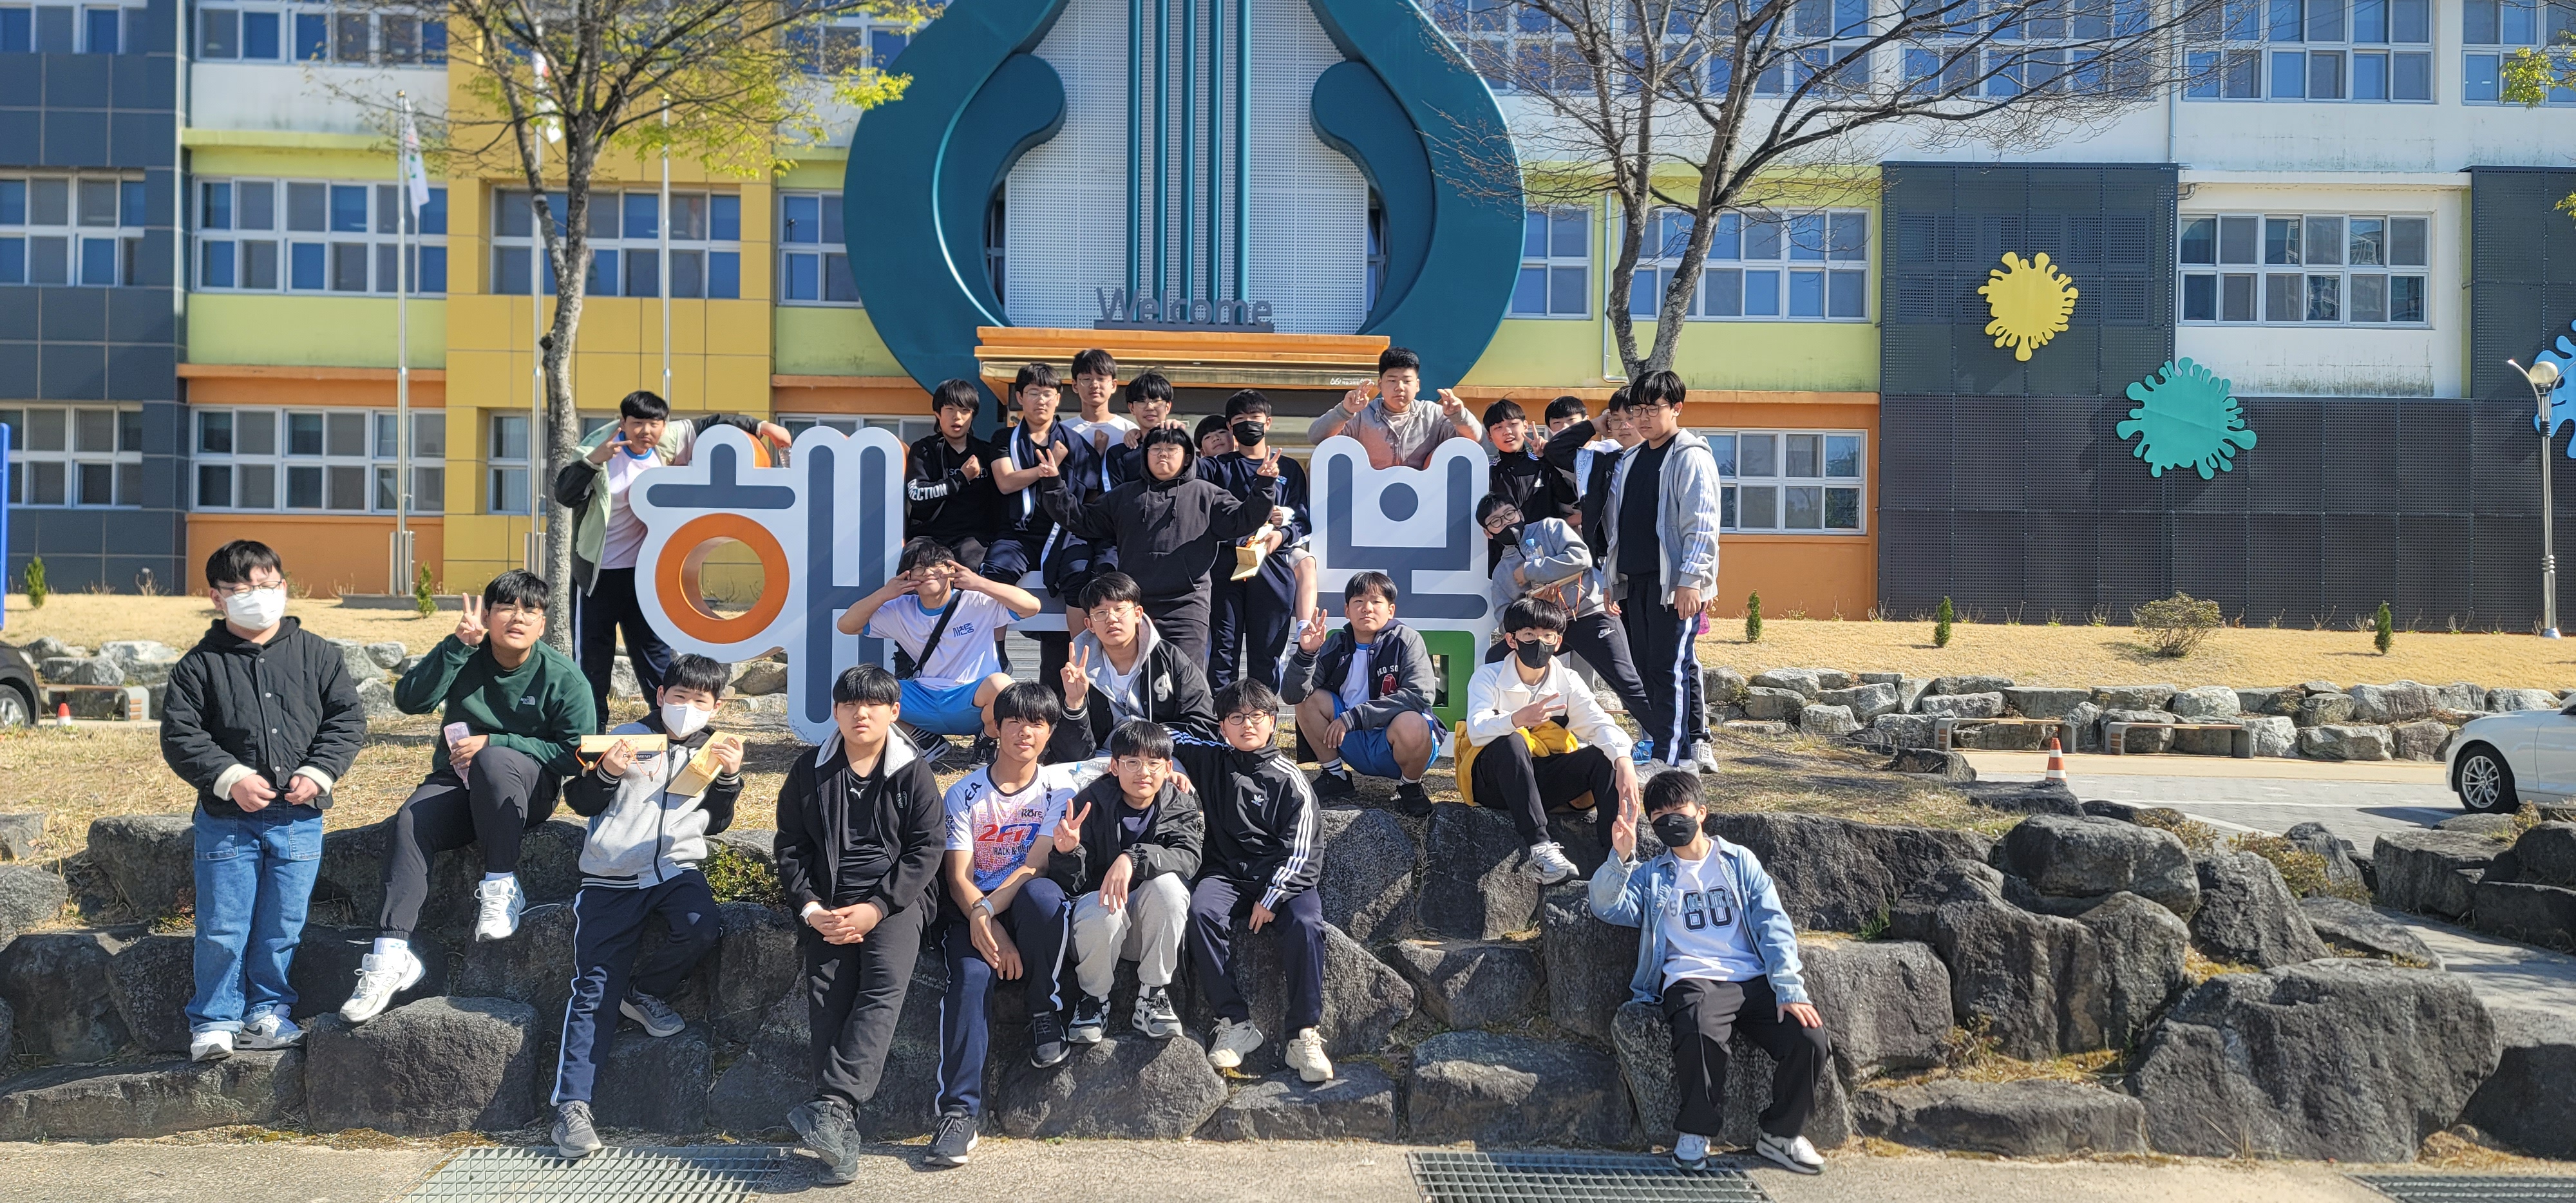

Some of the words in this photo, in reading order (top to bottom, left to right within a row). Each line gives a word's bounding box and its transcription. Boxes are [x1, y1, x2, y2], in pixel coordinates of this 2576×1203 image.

[1096, 287, 1273, 326] Welcome
[953, 622, 974, 638] 사천중
[1012, 846, 1016, 855] &
